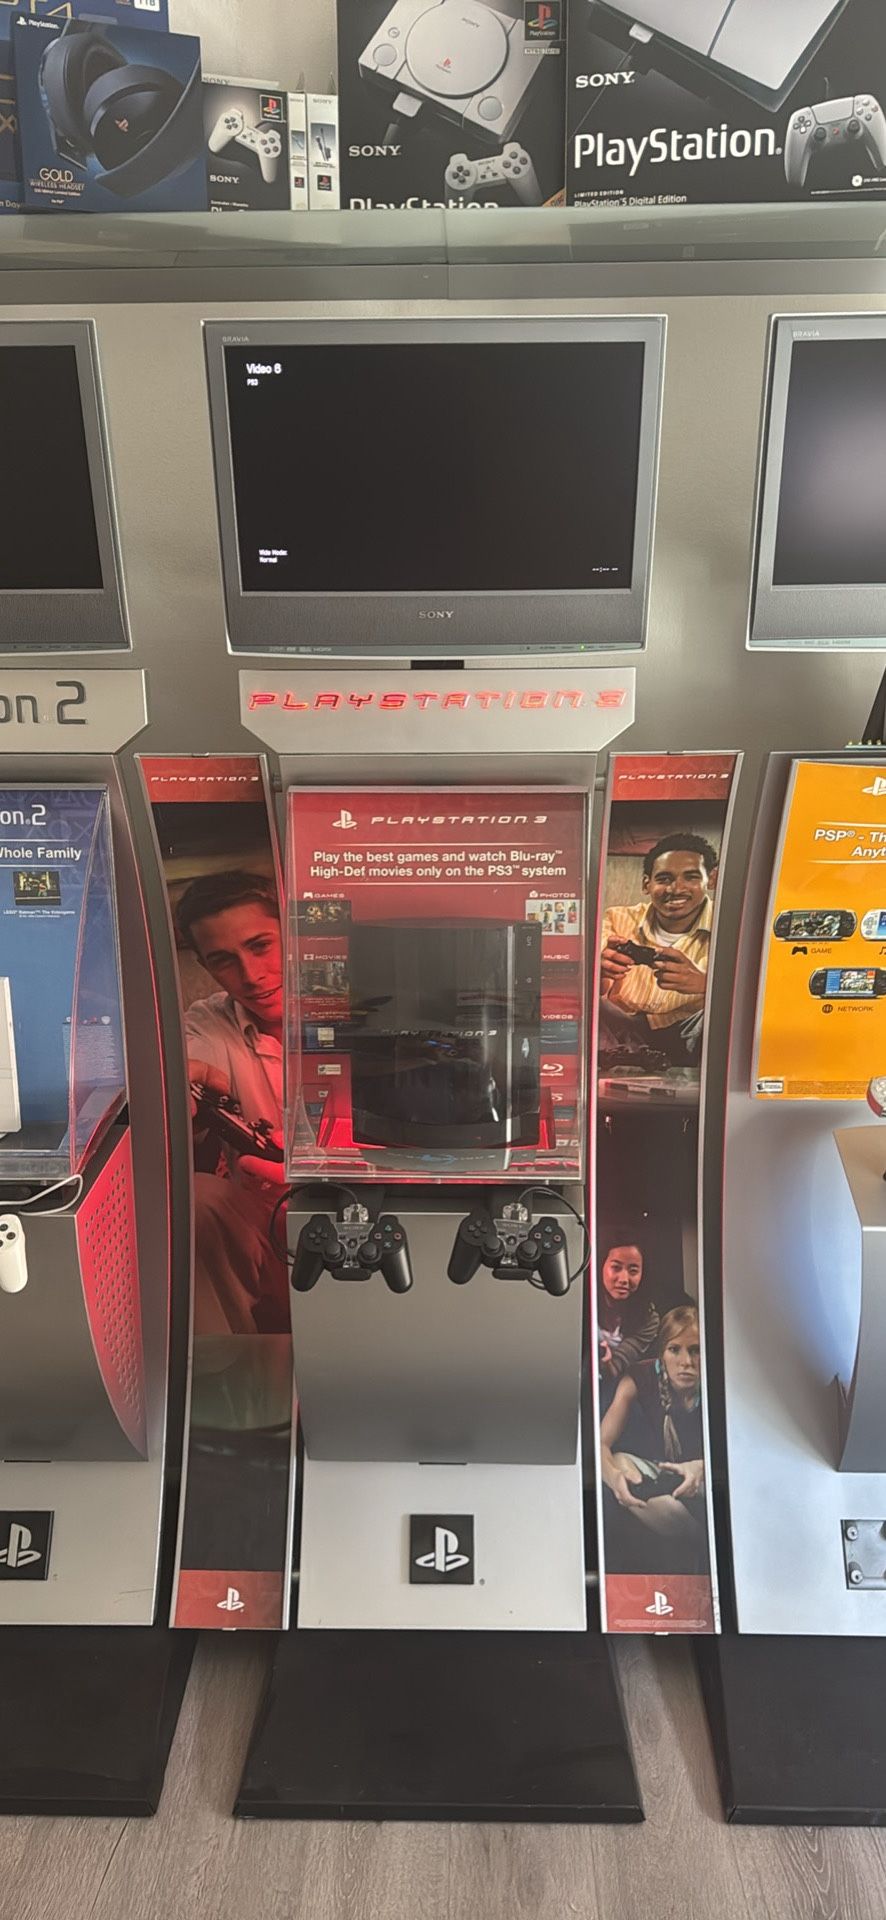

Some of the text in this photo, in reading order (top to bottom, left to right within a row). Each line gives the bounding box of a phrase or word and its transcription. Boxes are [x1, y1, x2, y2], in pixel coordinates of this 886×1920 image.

[28, 19, 59, 30] PlayStation
[573, 71, 635, 88] SONY
[348, 145, 401, 158] SONY
[573, 124, 777, 177] PlayStation
[39, 168, 74, 183] GOLD
[209, 174, 240, 184] SONY
[574, 191, 599, 199] LIMITED
[628, 196, 656, 206] Digital
[657, 193, 687, 204] Edition
[793, 330, 820, 338] BRAVIA
[246, 363, 272, 374] Video
[247, 378, 259, 386] PS3
[419, 610, 455, 618] SONY
[56, 681, 86, 724] 2
[249, 689, 628, 711] PLAYSTATION 3
[371, 815, 548, 825] PLAYSTATION 3
[37, 847, 82, 861] Family
[313, 851, 340, 864] Play
[343, 851, 363, 862] the
[366, 851, 394, 862] best
[397, 853, 439, 864] games
[441, 851, 466, 862] and
[468, 850, 506, 862] watch
[310, 865, 366, 879] High-Def
[368, 866, 413, 877] movies
[416, 865, 442, 878] only
[445, 867, 461, 876] on
[464, 865, 485, 876] the
[521, 867, 567, 878] system
